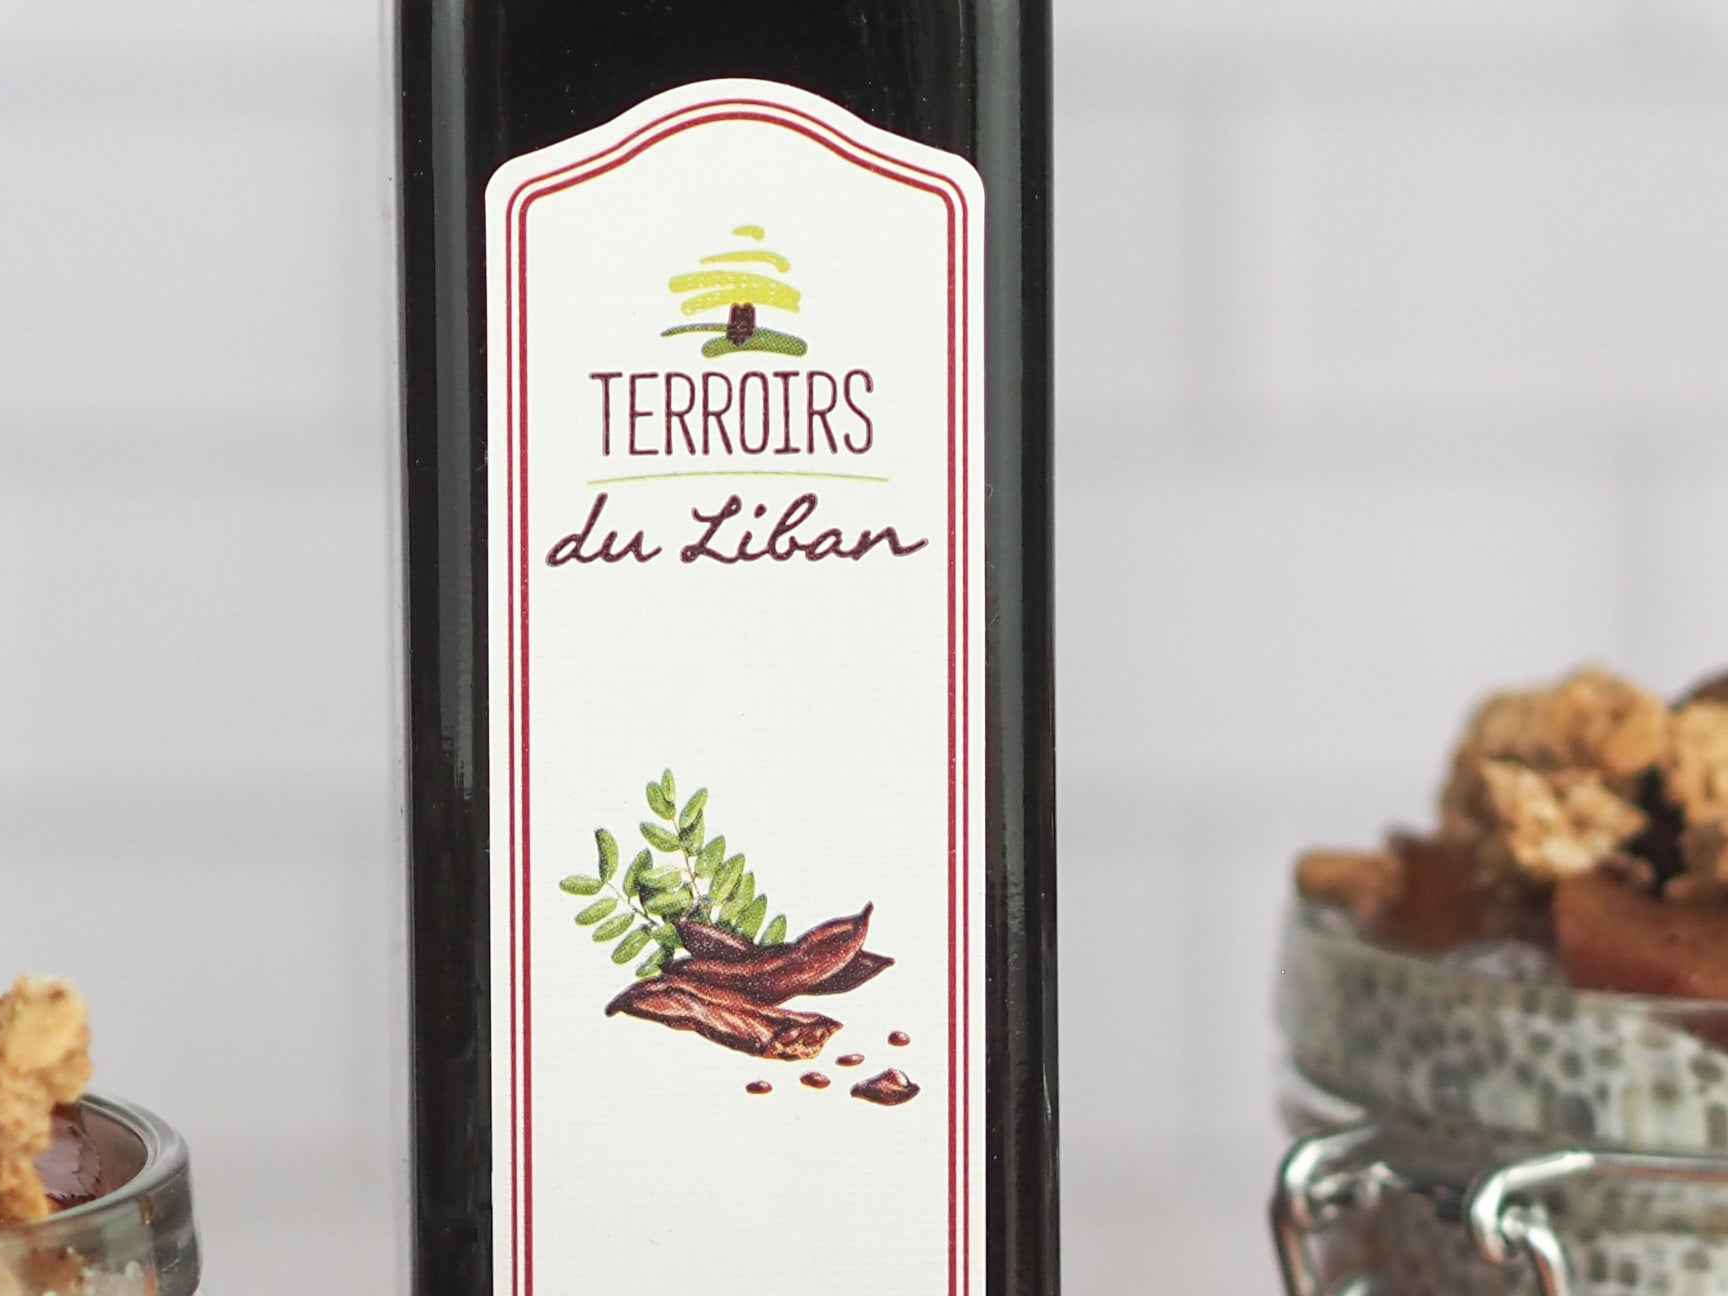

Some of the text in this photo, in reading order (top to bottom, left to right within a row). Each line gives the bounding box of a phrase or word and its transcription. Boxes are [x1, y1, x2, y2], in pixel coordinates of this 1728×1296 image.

[588, 368, 874, 457] TERROIRS
[544, 492, 929, 568] du Liban
